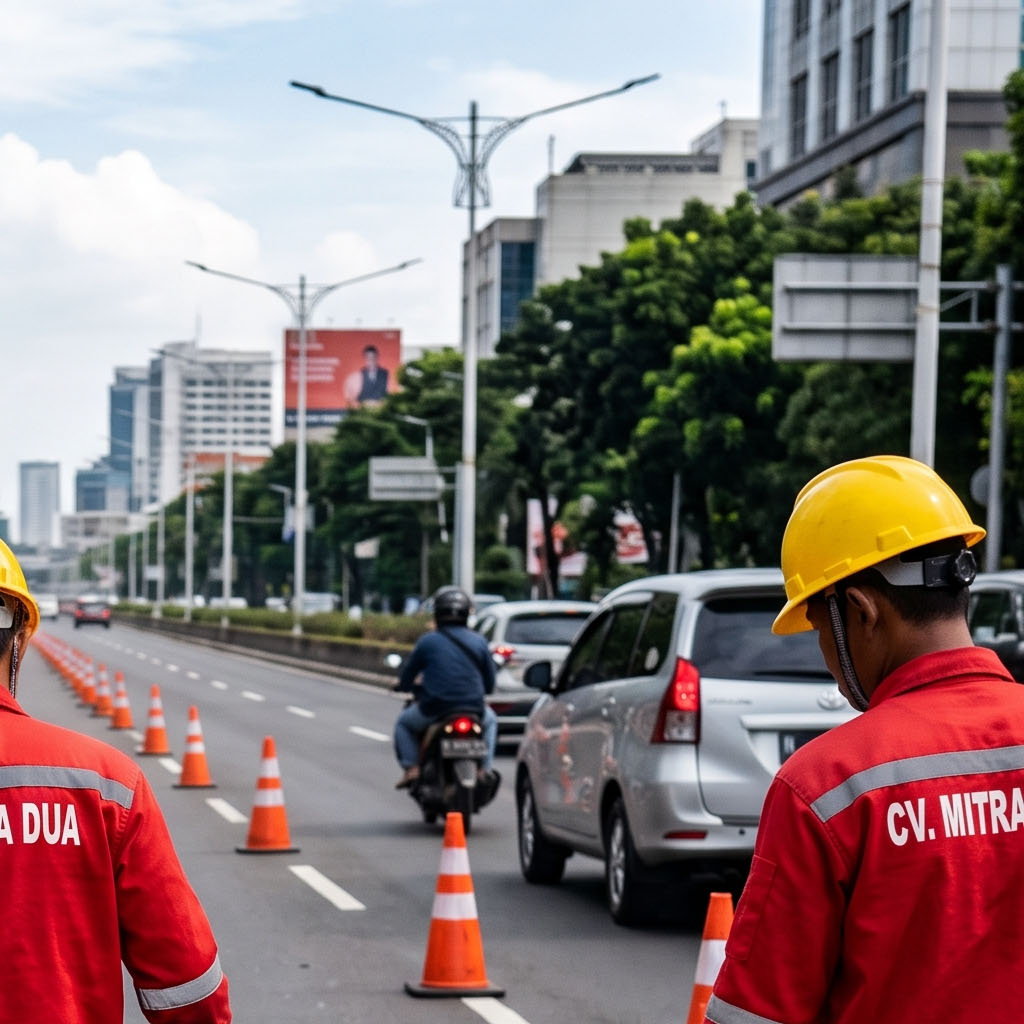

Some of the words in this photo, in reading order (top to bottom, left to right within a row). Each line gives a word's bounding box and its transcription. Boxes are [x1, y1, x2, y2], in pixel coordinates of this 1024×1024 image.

[22, 802, 81, 846] DUA
[886, 797, 937, 847] CV.
[938, 787, 1024, 838] MITRA
